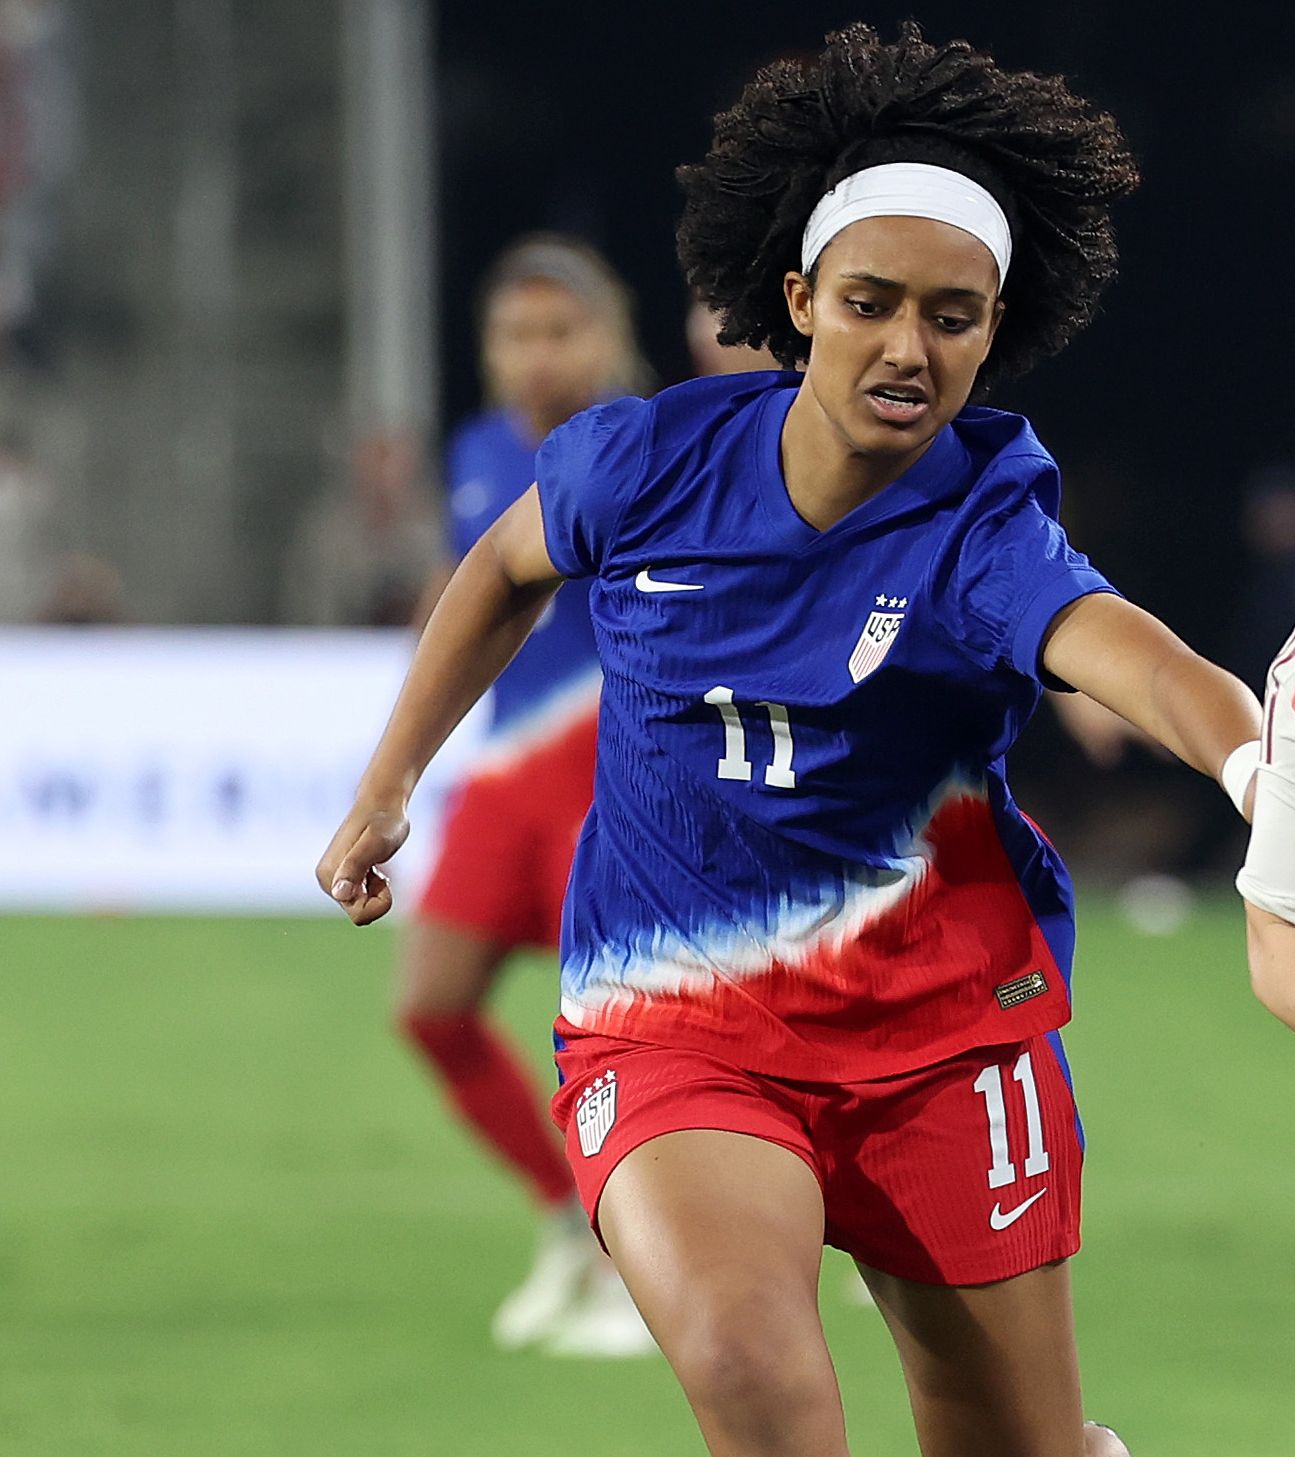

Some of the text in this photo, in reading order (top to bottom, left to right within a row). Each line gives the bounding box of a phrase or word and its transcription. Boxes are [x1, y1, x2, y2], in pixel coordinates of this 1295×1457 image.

[866, 616, 901, 643] USA
[704, 685, 796, 789] 11
[579, 1087, 612, 1126] USA
[973, 1051, 1050, 1189] 11
